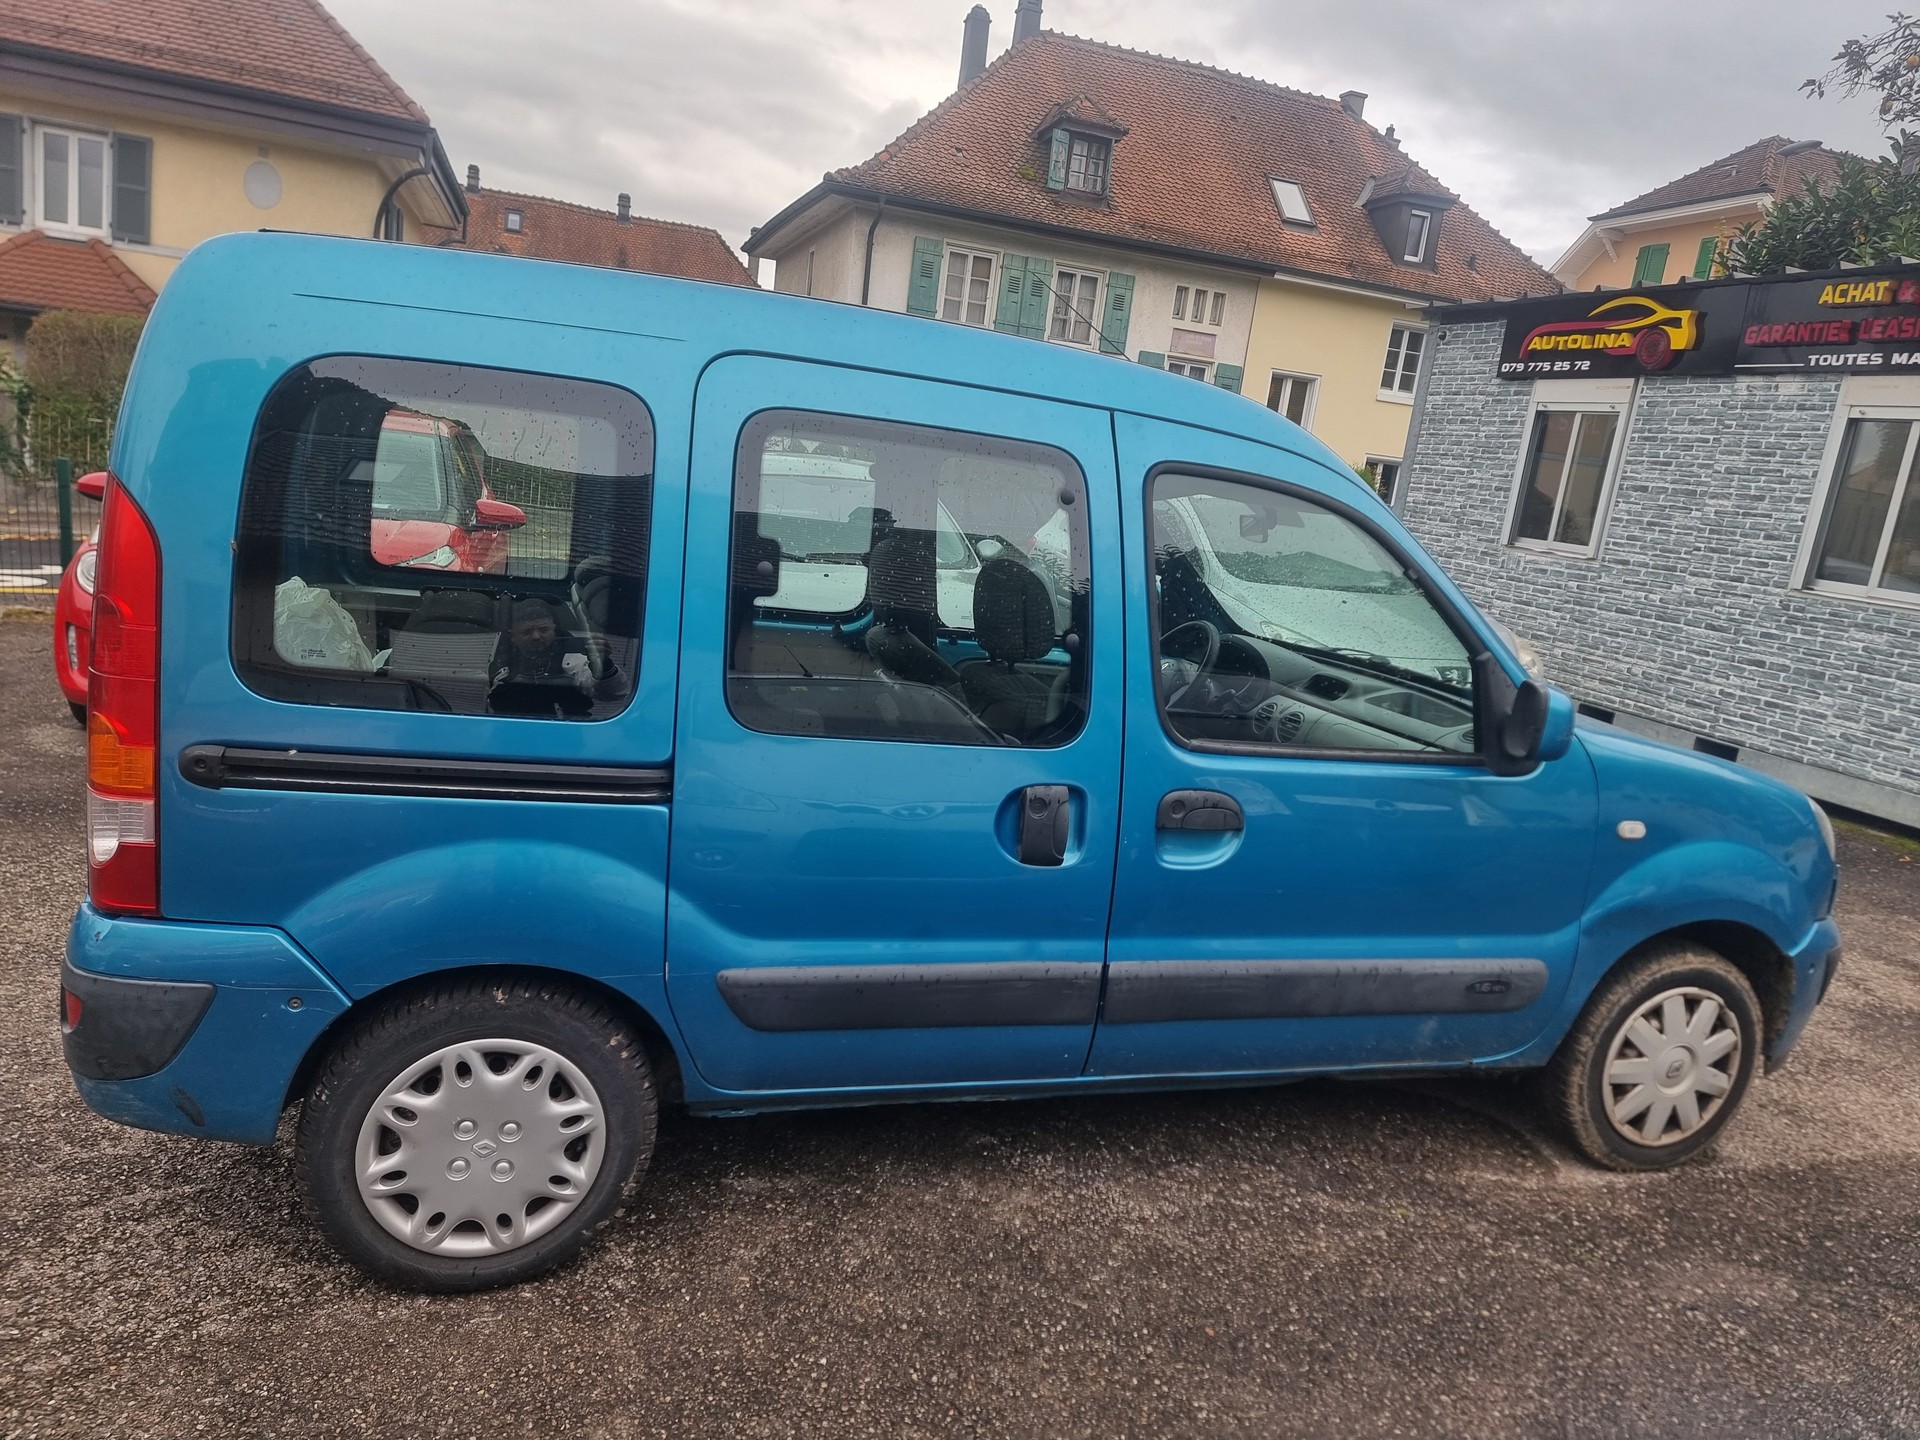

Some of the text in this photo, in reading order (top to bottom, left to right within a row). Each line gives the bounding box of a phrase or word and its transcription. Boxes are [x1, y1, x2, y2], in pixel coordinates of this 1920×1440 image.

[1818, 280, 1891, 305] ACHAT
[1527, 332, 1631, 350] AUTOLINA
[1500, 360, 1591, 373] 079 775 25 72
[1807, 352, 1884, 367] TOUTES
